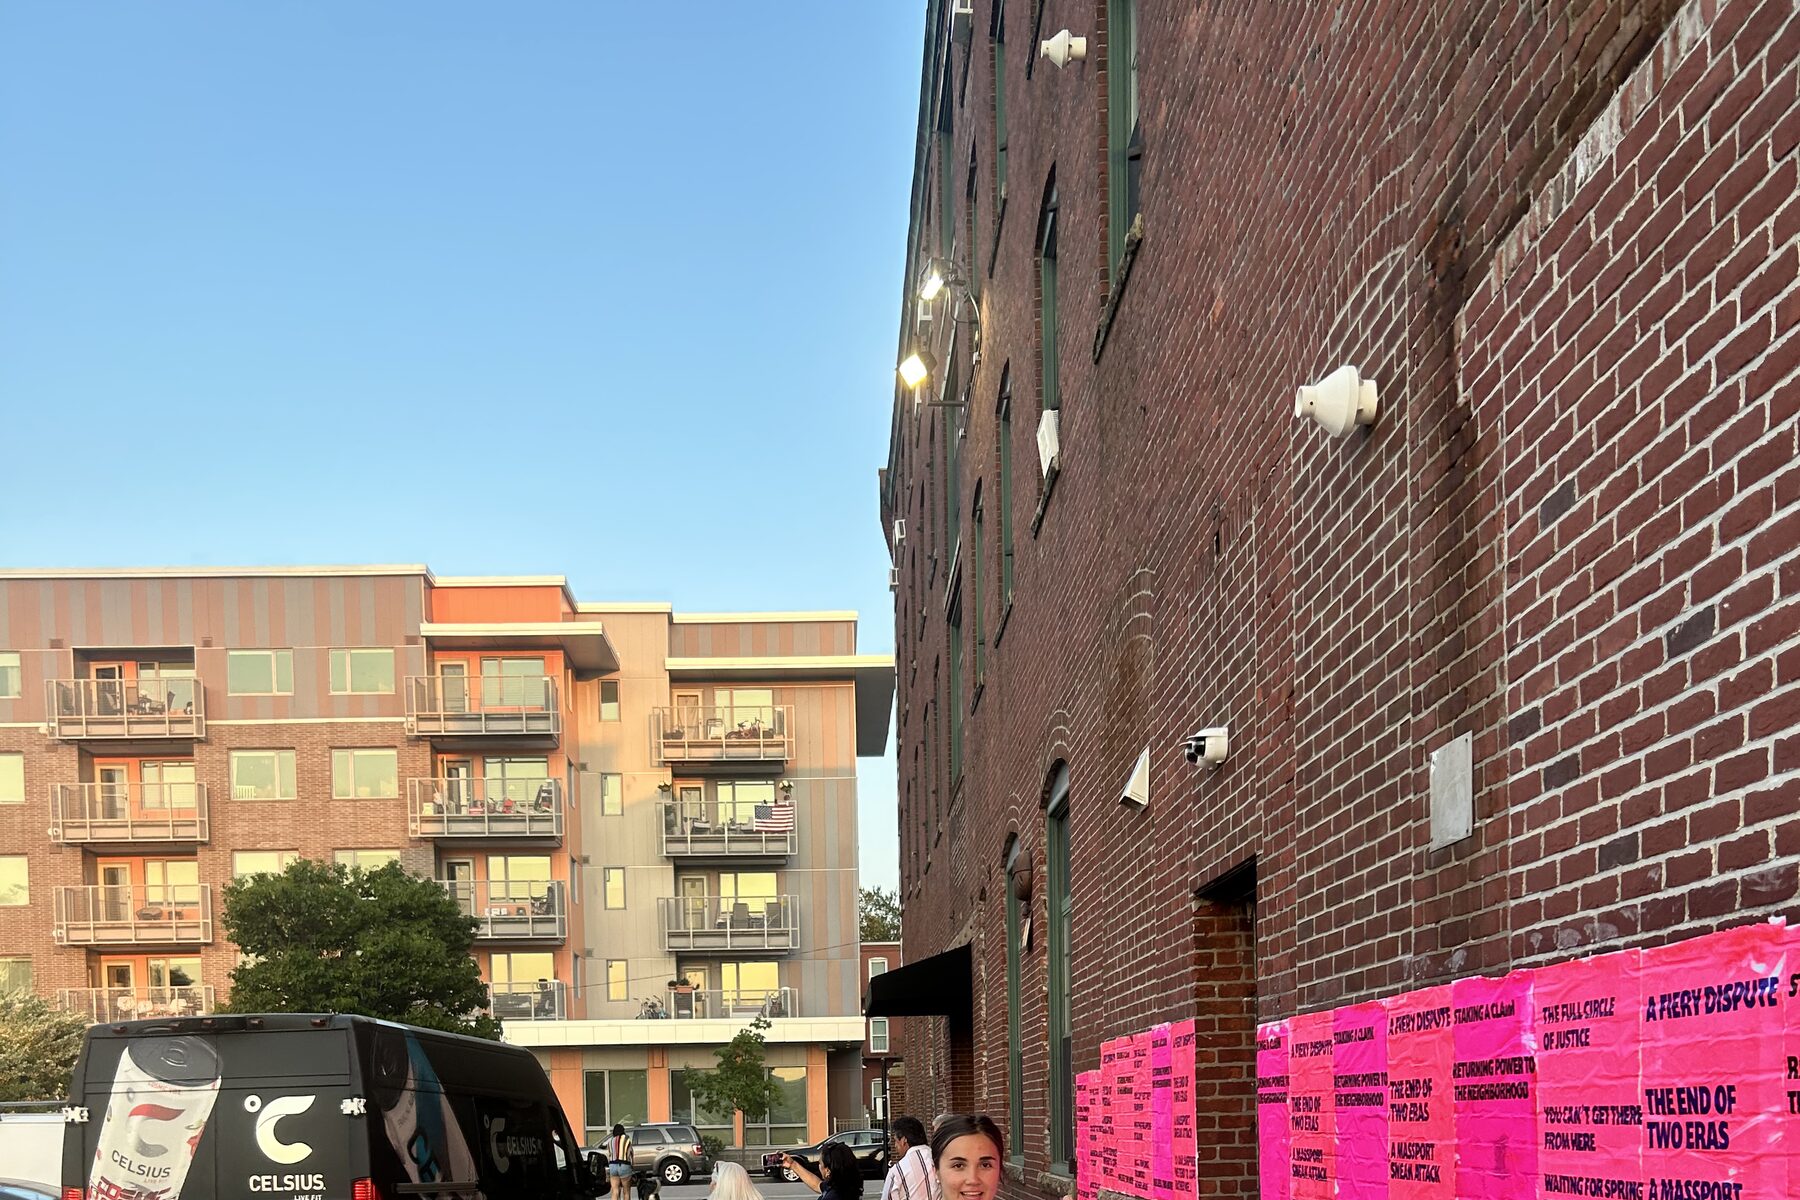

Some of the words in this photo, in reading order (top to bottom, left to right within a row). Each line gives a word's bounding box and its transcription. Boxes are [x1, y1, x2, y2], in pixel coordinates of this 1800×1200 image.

[1543, 1005, 1560, 1024] THE
[1561, 1002, 1583, 1022] FULL
[1584, 997, 1616, 1019] CIRCLE
[1646, 996, 1657, 1022] A
[1660, 988, 1702, 1020] FIERY
[1704, 977, 1779, 1014] DISPUTE
[1388, 1018, 1394, 1036] A
[1395, 1013, 1416, 1034] FIERY
[1417, 1007, 1451, 1031] DISPUTE
[1453, 1005, 1484, 1025] STAKING
[1484, 1004, 1491, 1020] A
[1543, 1032, 1554, 1050] OF
[1555, 1028, 1590, 1049] JUSTICE
[1453, 1058, 1494, 1078] RETURNING
[1495, 1057, 1523, 1075] POWER
[1524, 1056, 1536, 1073] TO
[1390, 1080, 1404, 1099] THE
[1405, 1079, 1421, 1099] END
[1422, 1078, 1432, 1098] OF
[1454, 1085, 1466, 1101] THE
[1467, 1082, 1529, 1101] NEIGHBORHOOD
[1645, 1088, 1676, 1115] THE
[1676, 1086, 1711, 1115] END
[1714, 1085, 1736, 1114] OF
[1390, 1103, 1408, 1122] TWO
[1409, 1102, 1429, 1122] ERAS
[1544, 1106, 1561, 1124] YOU
[1563, 1104, 1590, 1125] CAN'T
[1592, 1105, 1610, 1125] GET
[1610, 1105, 1643, 1125] THERE
[1544, 1132, 1570, 1150] FROM
[1647, 1121, 1683, 1149] TWO
[1686, 1121, 1729, 1150] ERAS
[1391, 1142, 1396, 1158] A
[1397, 1141, 1435, 1160] MASSPORT
[111, 1149, 171, 1178] CELSIUS
[1391, 1162, 1413, 1180] SNEAK
[1414, 1164, 1441, 1183] ATTACK
[1544, 1173, 1584, 1195] WAITING
[1585, 1177, 1603, 1198] FOR
